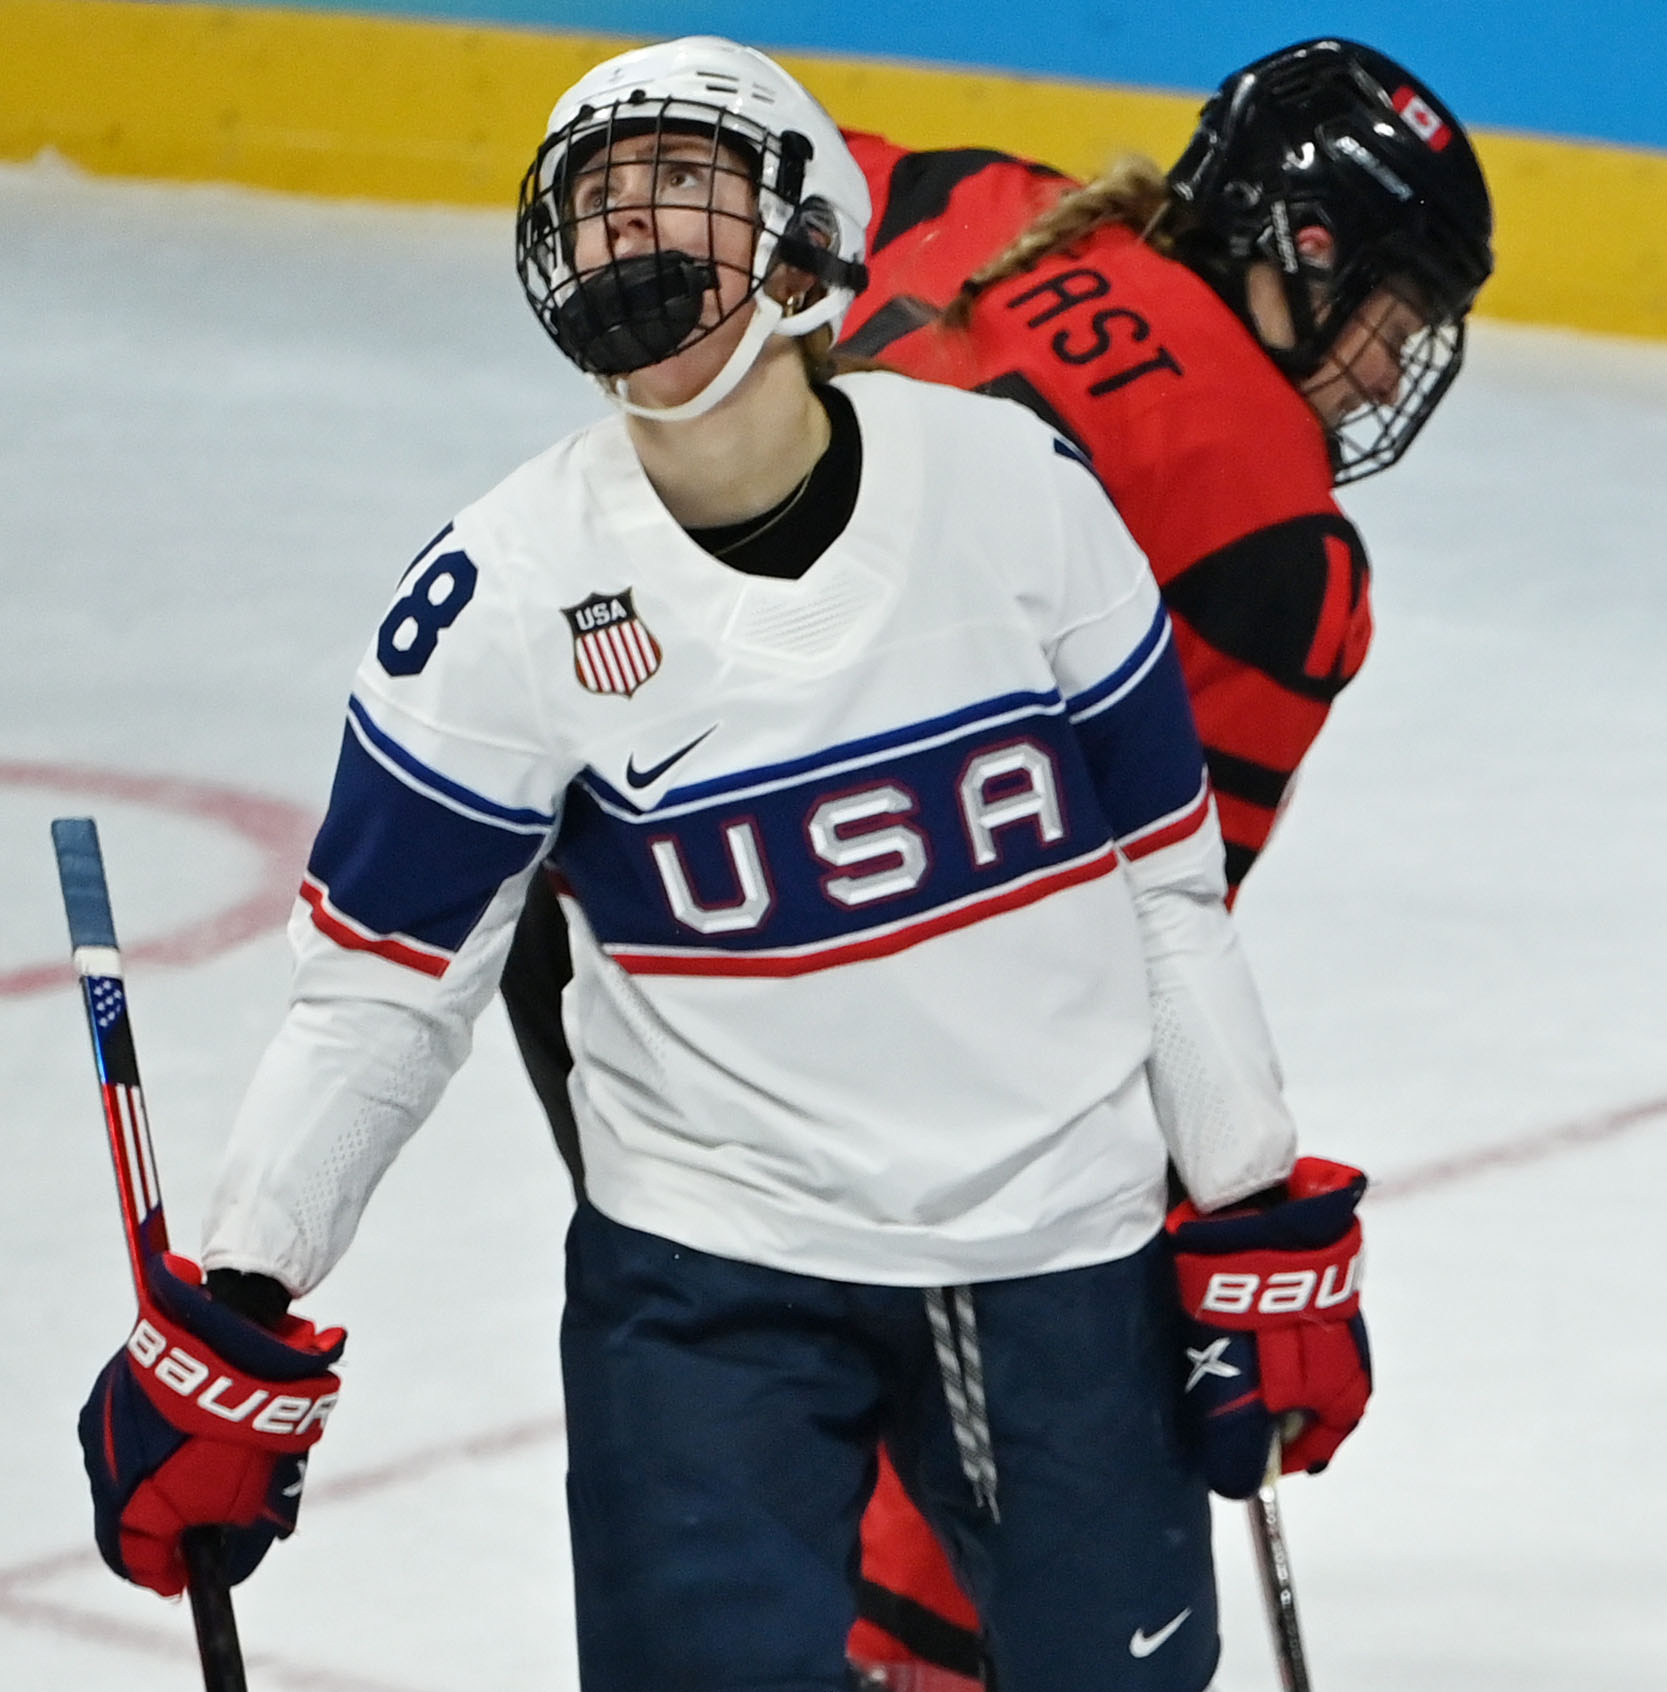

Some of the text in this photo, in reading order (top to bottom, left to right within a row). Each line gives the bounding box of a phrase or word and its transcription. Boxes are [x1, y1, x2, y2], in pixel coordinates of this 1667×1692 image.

[1007, 268, 1183, 397] AST
[376, 520, 479, 678] 8
[574, 598, 628, 632] USA
[651, 742, 1066, 935] USA
[126, 1318, 340, 1438] BAUER
